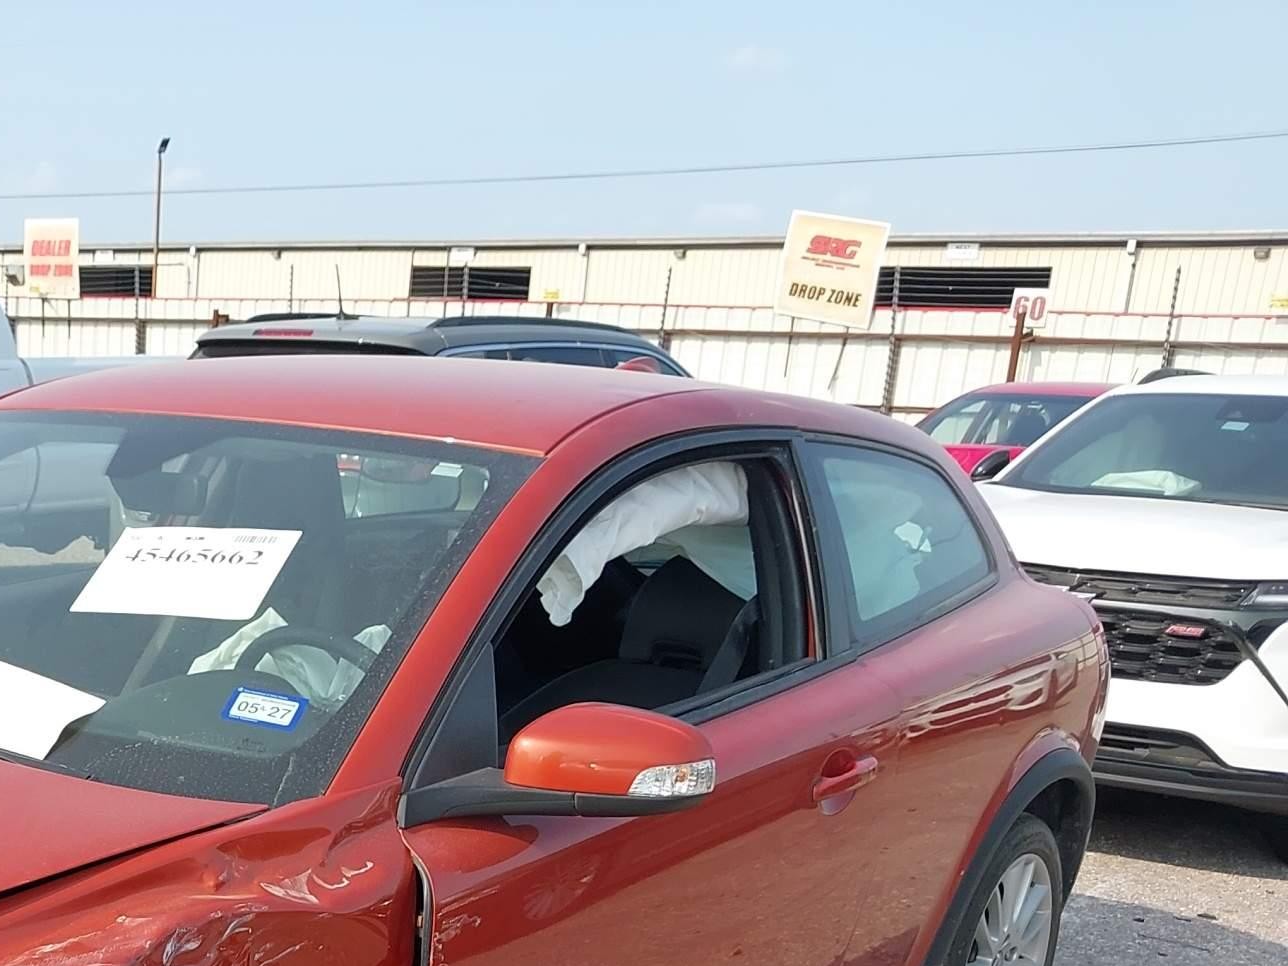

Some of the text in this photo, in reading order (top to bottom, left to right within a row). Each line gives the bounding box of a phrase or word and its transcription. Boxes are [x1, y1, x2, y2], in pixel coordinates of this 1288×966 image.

[31, 240, 71, 256] DEALER
[788, 282, 863, 308] DROP ZONE
[1013, 295, 1046, 321] 60
[125, 548, 264, 566] 45465662
[237, 700, 261, 714] 05
[267, 706, 292, 720] 27
